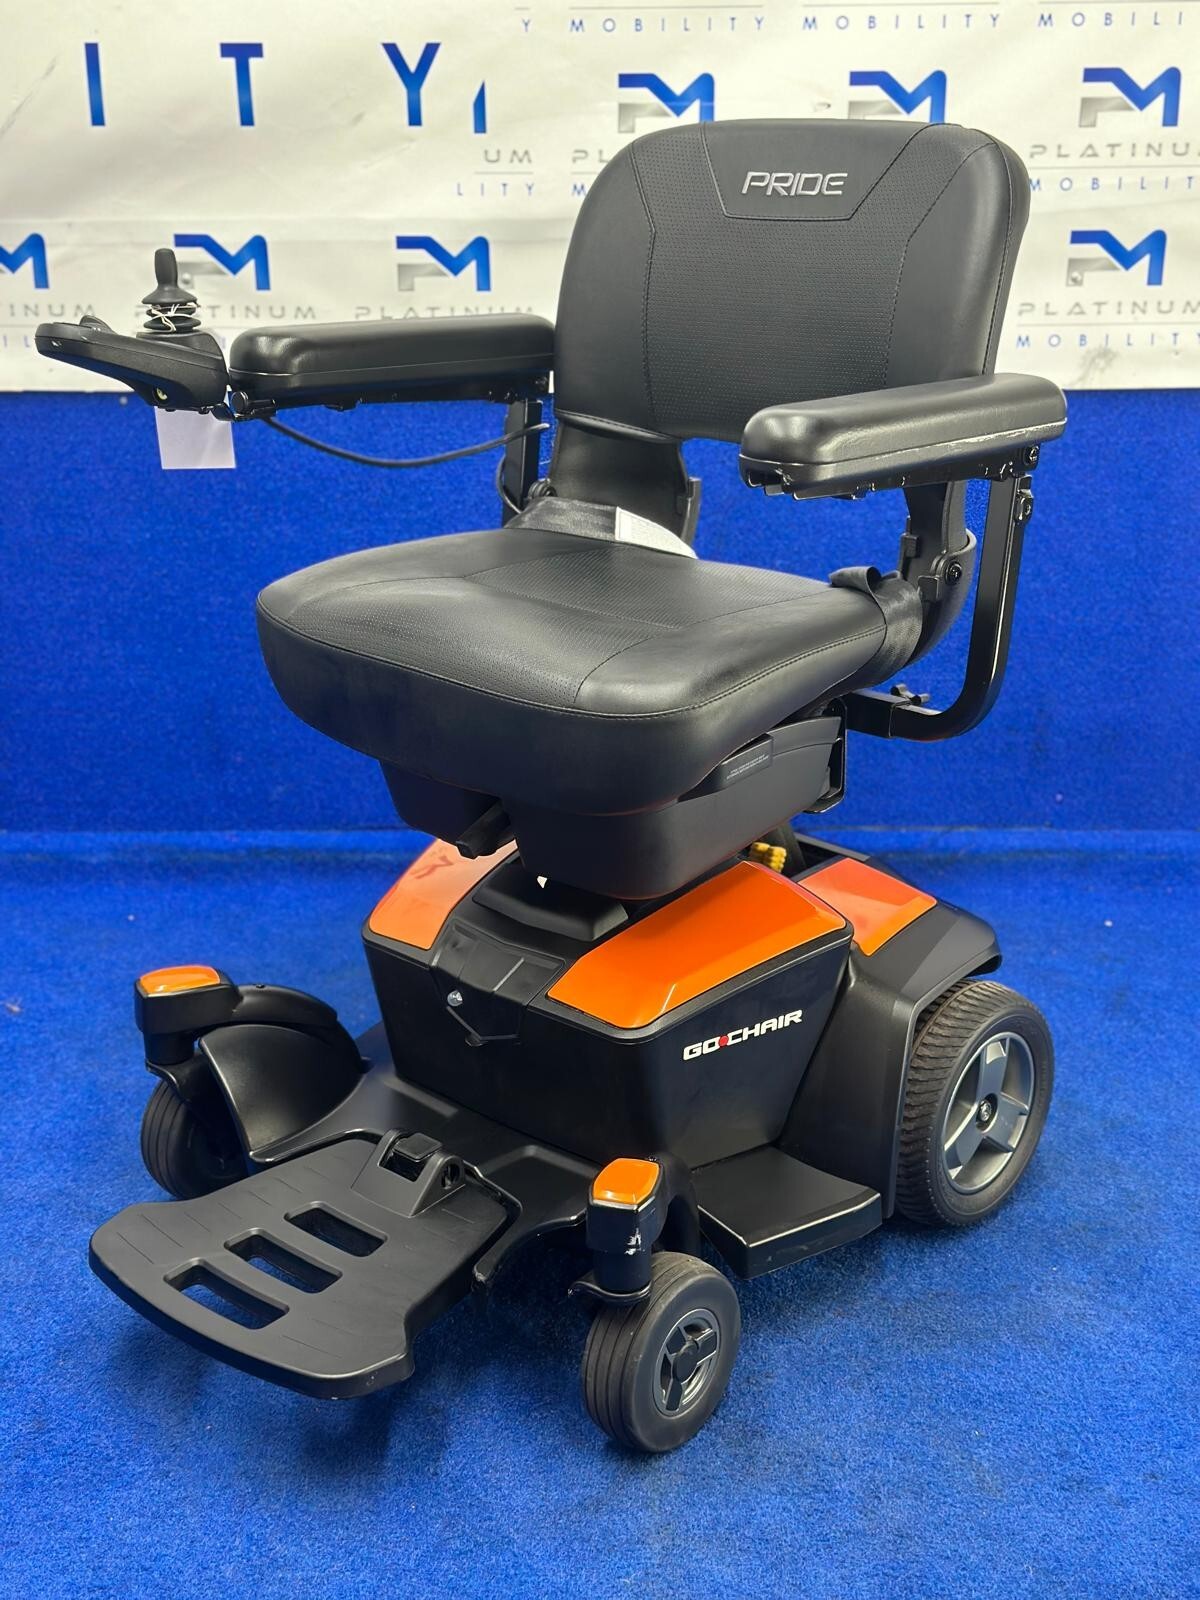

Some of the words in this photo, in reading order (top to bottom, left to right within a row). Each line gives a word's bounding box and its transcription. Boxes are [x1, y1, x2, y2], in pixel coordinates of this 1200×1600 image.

[569, 17, 765, 33] MOBILITY
[802, 14, 1001, 31] MOBILITY
[1029, 142, 1200, 158] PLATINU
[741, 171, 848, 197] PRIDE
